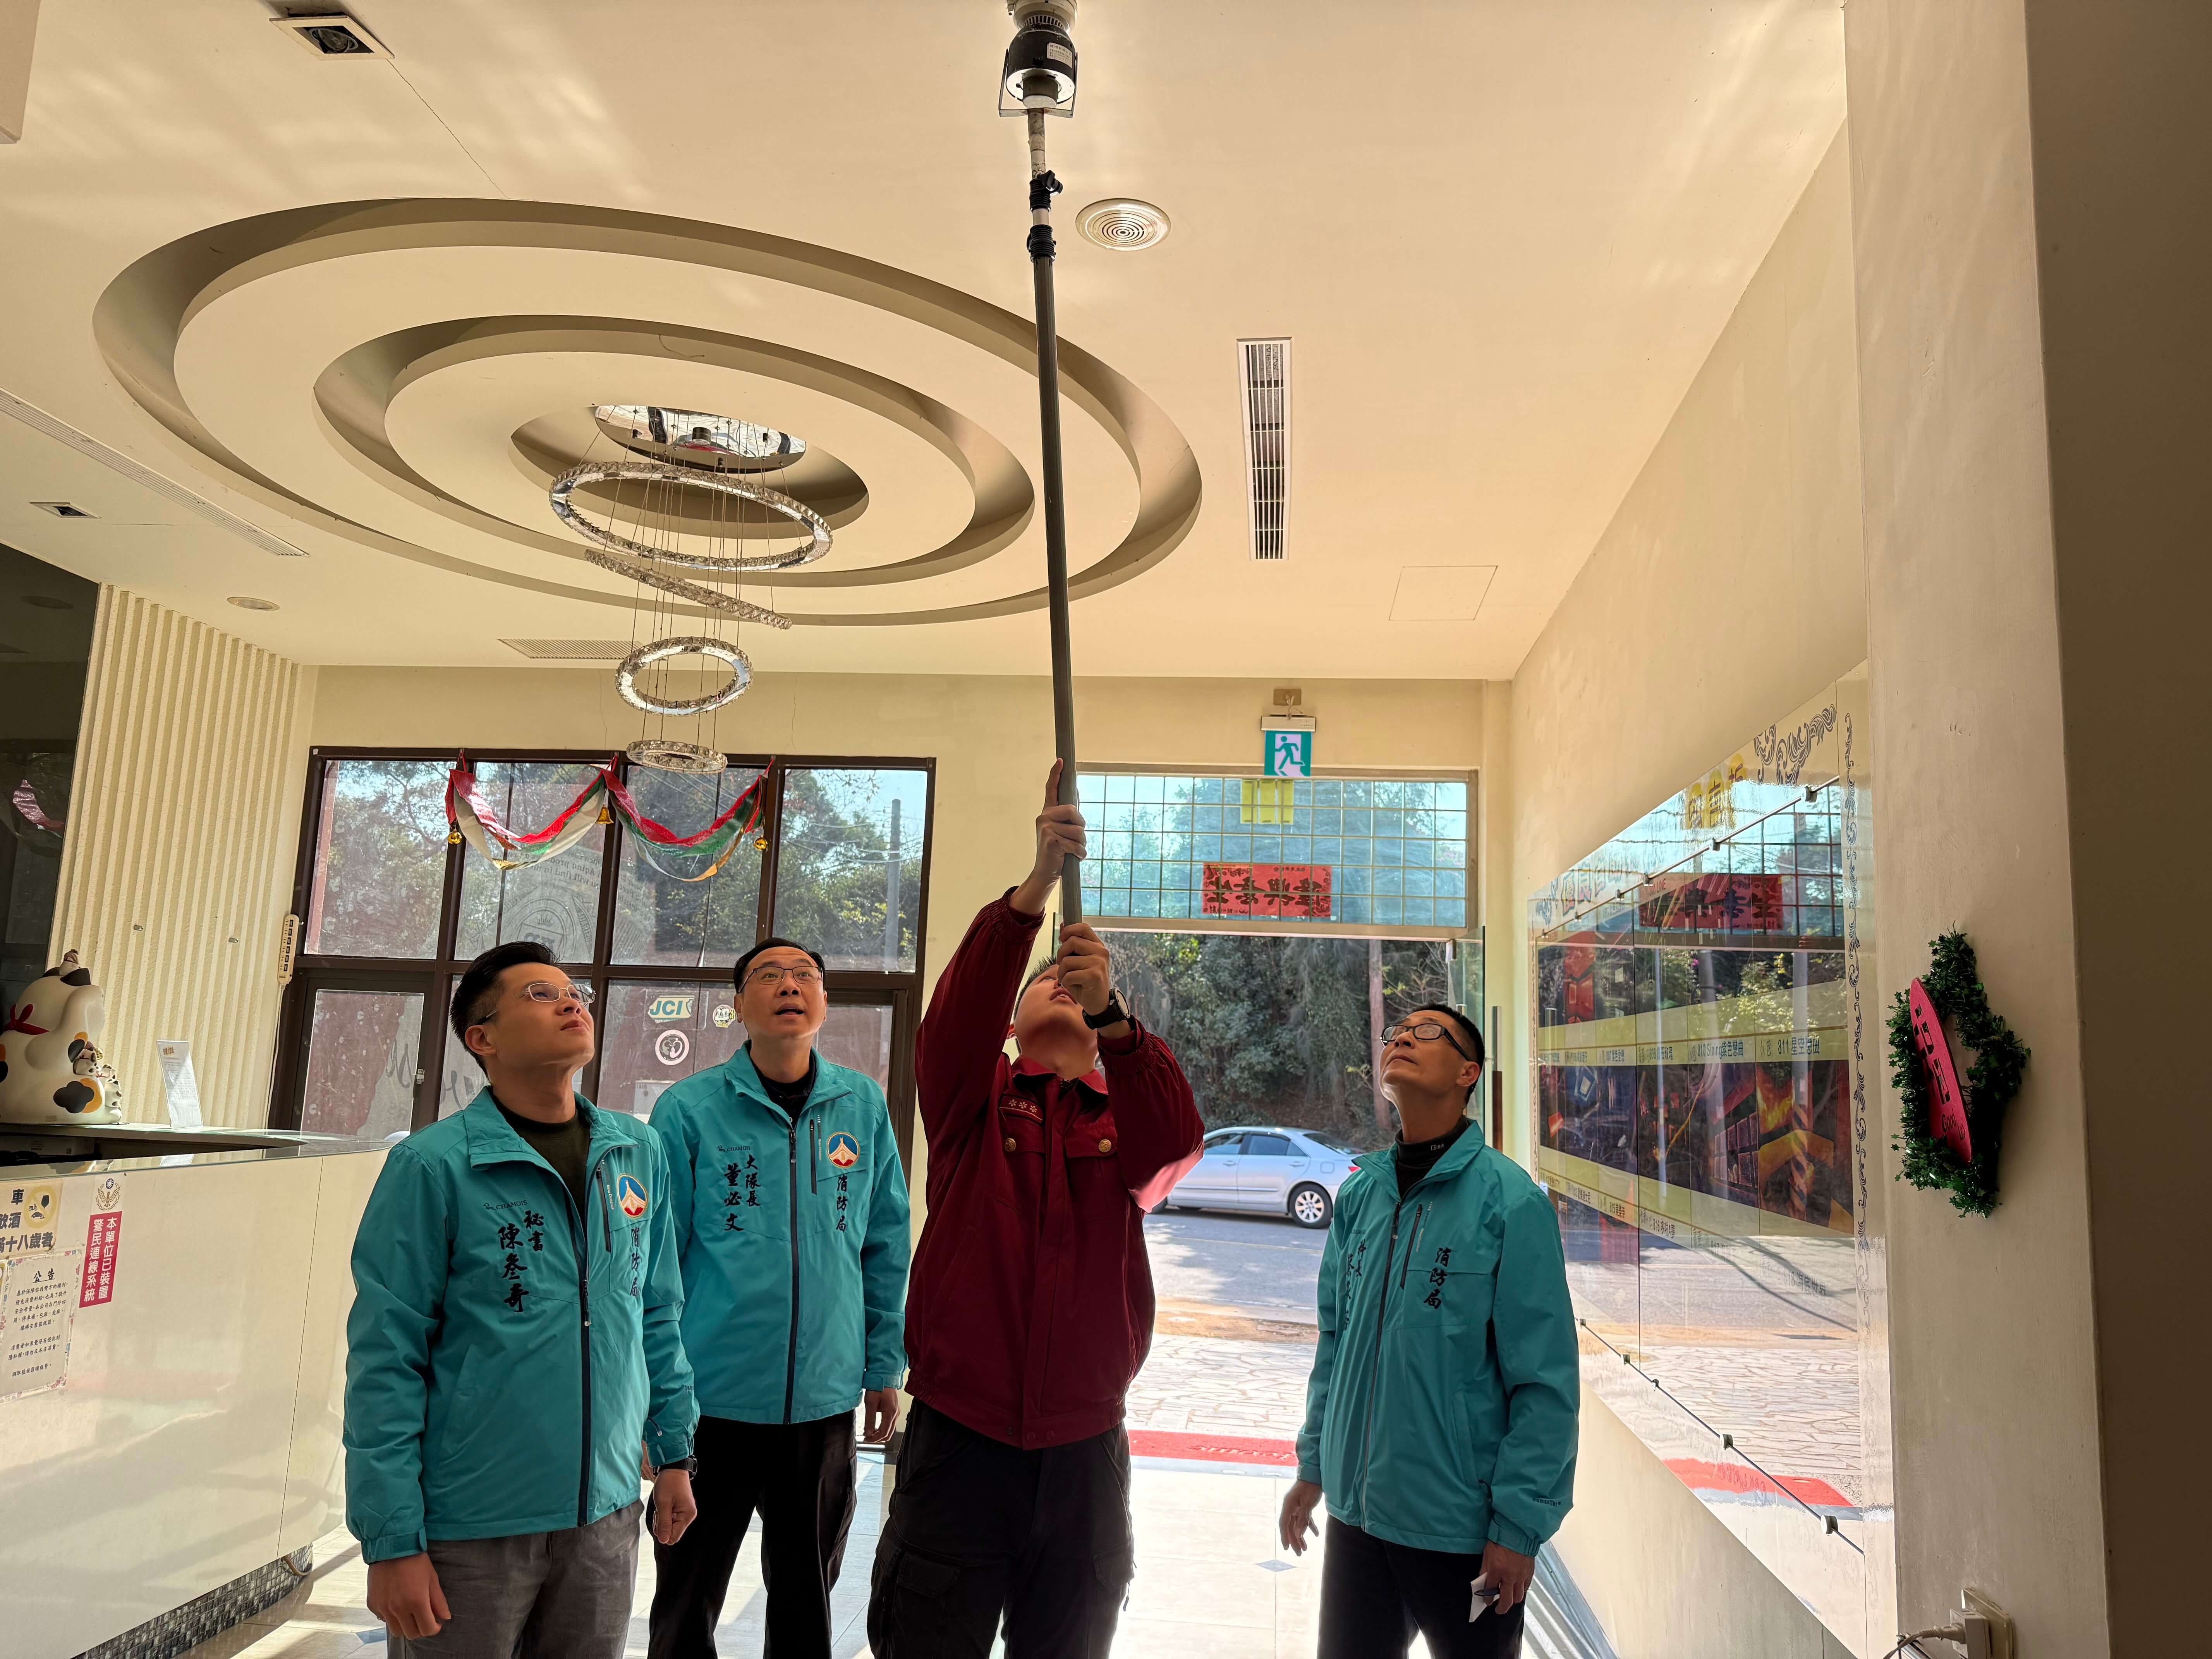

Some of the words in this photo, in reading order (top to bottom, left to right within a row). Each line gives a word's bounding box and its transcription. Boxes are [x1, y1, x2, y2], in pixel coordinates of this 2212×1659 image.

[650, 1000, 683, 1015] JCI
[11, 1189, 24, 1205] 車
[496, 1200, 527, 1210] CHAMOIS
[724, 1163, 744, 1231] 董必文
[744, 1154, 762, 1207] 大隊長
[836, 1173, 847, 1233] 消防局
[84, 1219, 104, 1302] 警民連線系統
[98, 1217, 117, 1299] 本單位已裝置
[1423, 1247, 1452, 1309] 消防局
